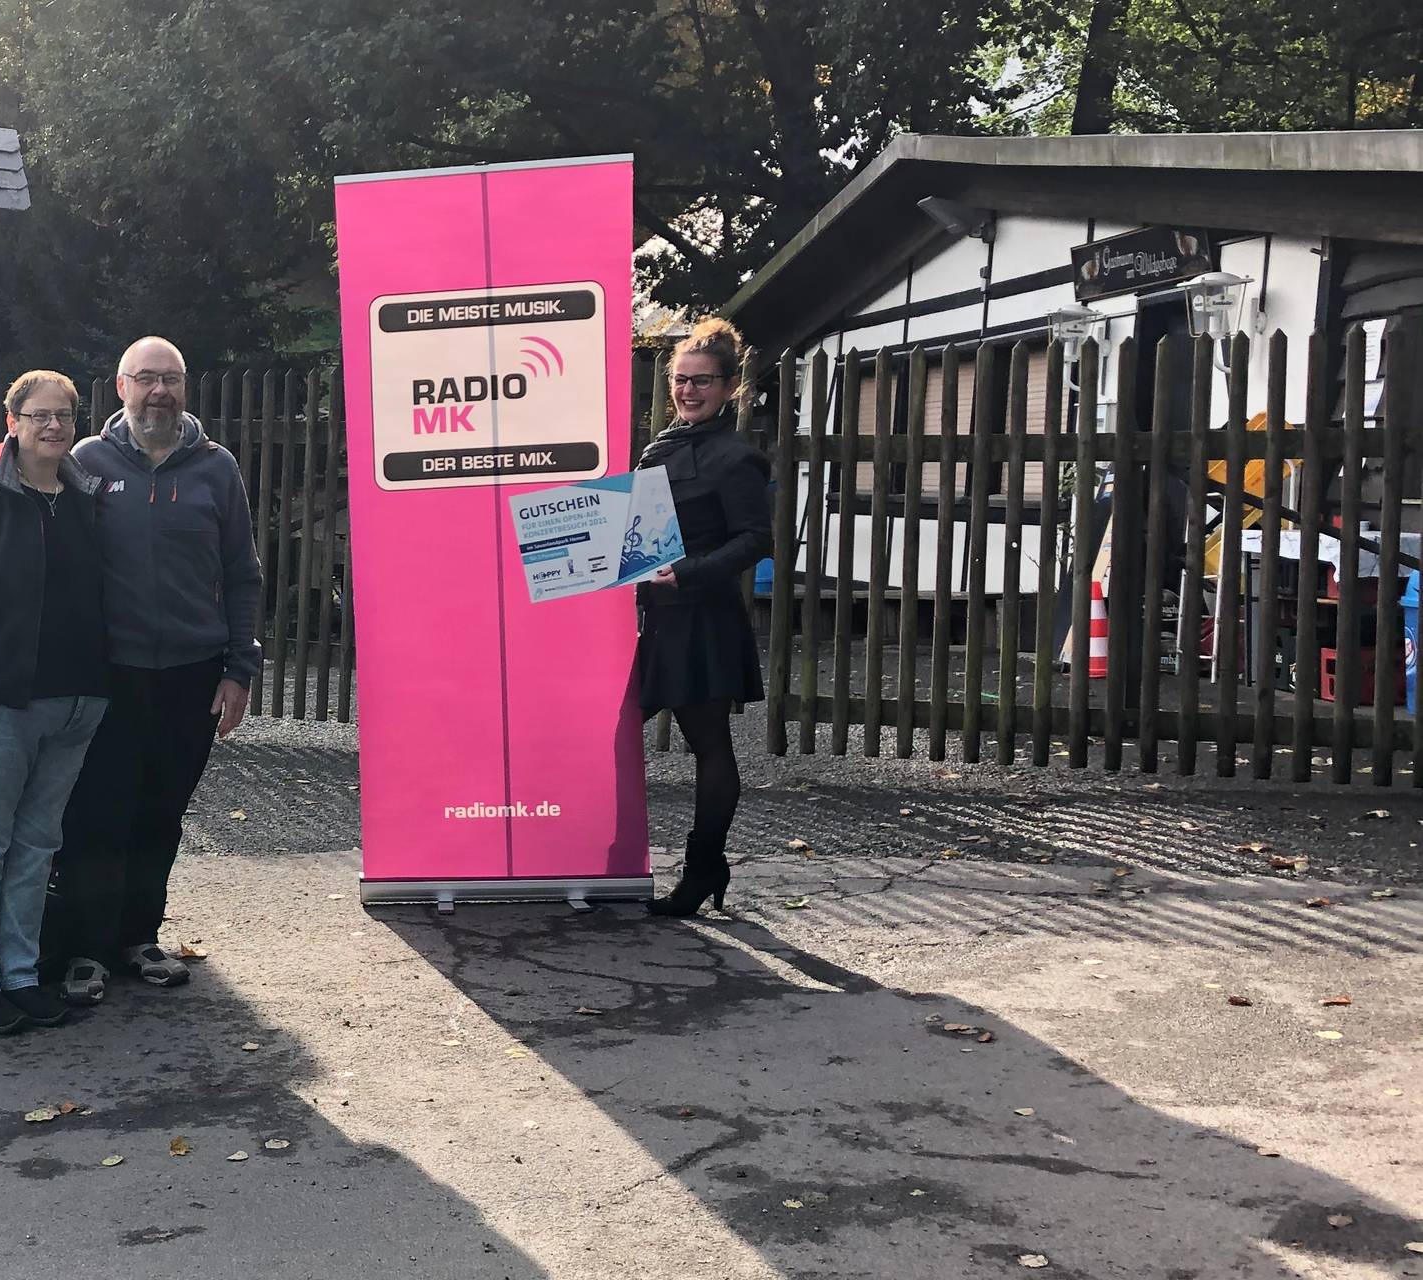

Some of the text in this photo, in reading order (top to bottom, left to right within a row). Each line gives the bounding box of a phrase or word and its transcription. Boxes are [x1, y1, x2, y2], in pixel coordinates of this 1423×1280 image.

[407, 299, 565, 324] DIE MEISTE MUSIK.
[412, 373, 527, 405] RADIO
[413, 404, 476, 434] MK
[422, 451, 557, 472] DER BESTE MIX.
[519, 494, 601, 520] GUTSCHEIN
[444, 800, 562, 819] radiomk.de
